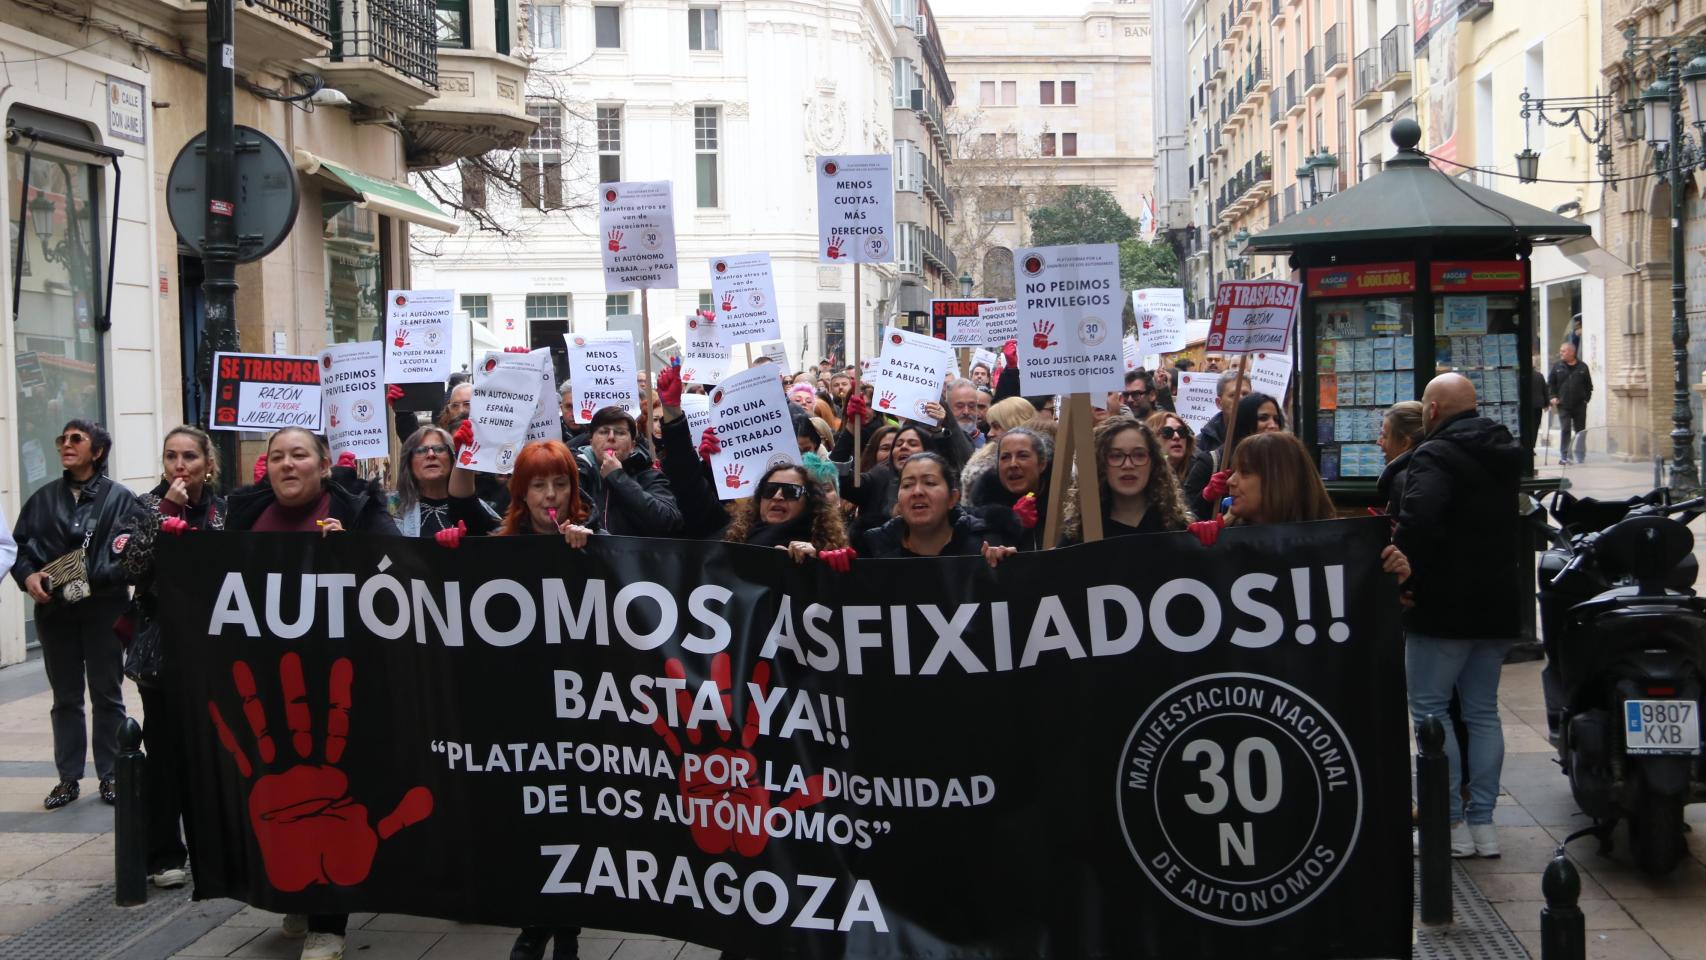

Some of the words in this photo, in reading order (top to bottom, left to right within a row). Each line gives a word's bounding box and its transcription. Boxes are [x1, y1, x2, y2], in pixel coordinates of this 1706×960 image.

[121, 92, 138, 107] CALLE
[111, 111, 124, 128] DON
[836, 181, 873, 189] MENOS
[844, 209, 866, 220] MÁS
[831, 226, 884, 235] DERECHOS
[871, 240, 882, 249] 30
[622, 253, 664, 262] AUTÓNOMO
[620, 274, 662, 283] SANCIONES
[1025, 282, 1046, 293] NO
[1050, 279, 1110, 292] PEDIMOS
[1027, 294, 1110, 310] PRIVILEGIOS
[1217, 285, 1233, 306] SE
[1233, 285, 1296, 307] TRASPASA
[933, 302, 945, 316] SE
[947, 301, 980, 317] TRASP
[721, 321, 747, 329] TRABAJA
[1242, 310, 1275, 325] RAZÓN
[732, 328, 766, 336] SANCIONES
[1085, 324, 1098, 334] 30
[1227, 335, 1244, 345] SER
[890, 358, 920, 371] BASTA
[923, 366, 936, 375] YA
[1026, 357, 1050, 366] SOLO
[1052, 355, 1091, 364] JUSTICIA
[1093, 353, 1117, 362] PARA
[220, 357, 240, 379] SE
[243, 359, 321, 383] TRASPASA
[585, 364, 625, 373] CUOTAS,
[1030, 368, 1076, 379] NUESTROS
[1078, 366, 1115, 376] OFICIOS
[1256, 368, 1274, 376] BASTA
[324, 375, 334, 385] NO
[335, 369, 377, 382] PEDIMOS
[595, 375, 615, 385] MÁS
[881, 369, 893, 377] DE
[895, 373, 939, 389] ABUSOS!!
[257, 385, 304, 401] RAZÓN
[325, 381, 376, 396] PRIVILEGIOS
[473, 388, 486, 397] SIN
[488, 390, 534, 402] AUTONOMOS
[583, 391, 631, 400] DERECHOS
[259, 401, 271, 409] NO
[357, 405, 368, 413] 30
[485, 403, 514, 413] ESPAÑA
[719, 405, 741, 418] POR
[743, 399, 766, 412] UNA
[241, 410, 317, 425] JUBILACIÓN
[479, 416, 487, 425] SE
[489, 417, 514, 428] HUNDE
[530, 419, 553, 429] ARAR!
[712, 409, 782, 435] CONDICIONES
[1181, 413, 1212, 421] DERECHO
[352, 438, 381, 446] OFICIOS
[720, 438, 734, 449] DE
[735, 425, 782, 444] TRABAJO
[502, 450, 512, 460] 30
[733, 442, 774, 460] DIGNAS
[208, 554, 733, 654] AUTÓNOMOS
[759, 564, 1350, 675] ASFIXIADOS!!
[553, 669, 732, 731] BASTA
[746, 681, 850, 749] YA!!
[1642, 704, 1691, 723] 9807
[1128, 686, 1264, 790] MANIFESTACION
[1270, 695, 1348, 792] NACIONAL
[1644, 724, 1682, 744] KXB
[683, 752, 751, 790] POR
[764, 759, 809, 796] LA
[822, 766, 996, 809] DIGNIDAD
[1181, 736, 1283, 815] 30
[522, 784, 568, 815] DE
[579, 785, 643, 819] LOS
[1218, 822, 1256, 866] N
[1152, 851, 1182, 884] DE
[1181, 844, 1335, 913] AUTONOMOS
[539, 844, 889, 934] ZARAGOZA
